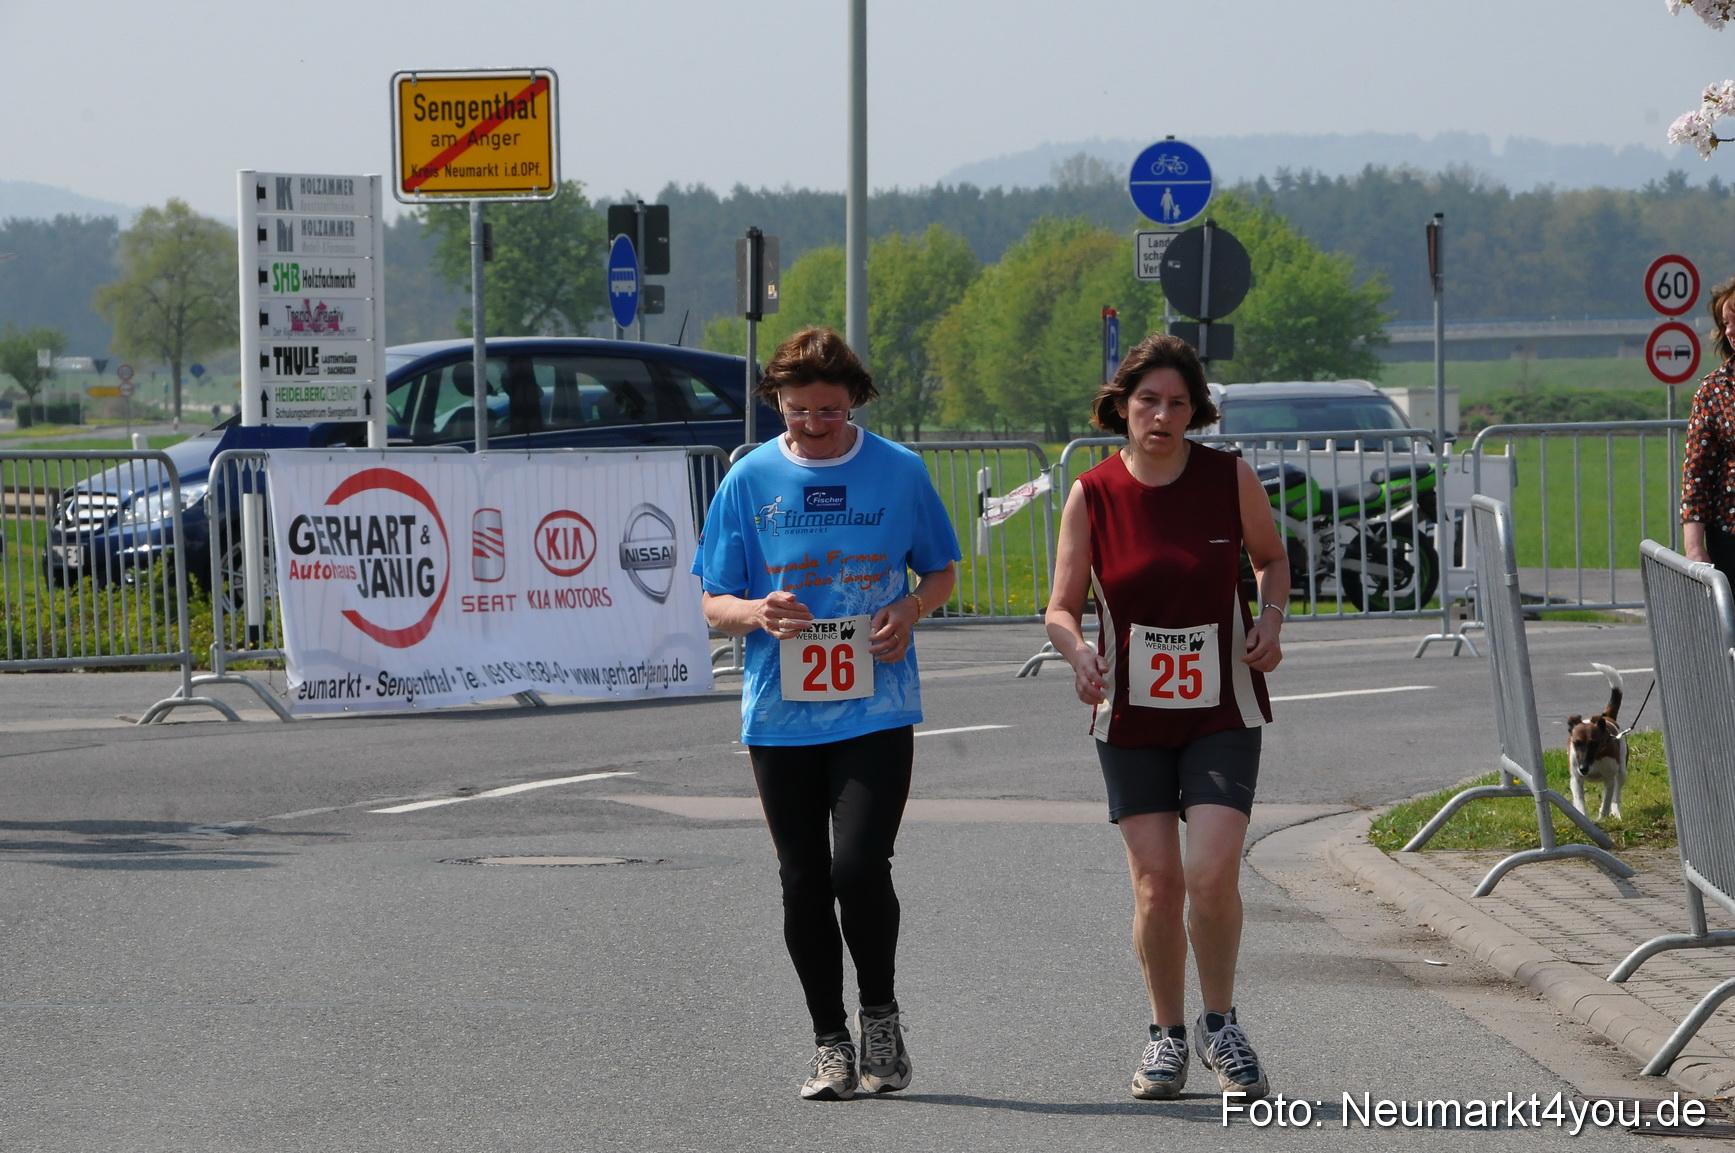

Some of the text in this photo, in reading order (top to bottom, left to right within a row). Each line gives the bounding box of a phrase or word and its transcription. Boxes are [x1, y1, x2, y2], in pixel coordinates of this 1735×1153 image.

[414, 91, 537, 129] Sengenthal
[431, 130, 520, 151] am Anger
[411, 162, 542, 178] Kreis Neumarkt i.d.OPf.
[300, 177, 354, 196] HOLZAMMER
[301, 219, 355, 237] HOLZAMMER
[1148, 237, 1170, 248] Land
[273, 262, 355, 294] SHB Holzfachmarkt
[1143, 263, 1159, 274] Ver
[1657, 271, 1688, 300] 60
[273, 346, 319, 375] THULE
[275, 406, 357, 420] Schulungszentrum Sengenthal
[813, 494, 844, 503] Fischer
[784, 508, 885, 527] firmenlauf
[288, 514, 431, 556] GERHART &
[785, 526, 828, 535] neumarkt
[545, 528, 586, 560] KIA
[827, 550, 887, 566] Firmen
[289, 559, 357, 580] Autohaus
[357, 557, 435, 598] JÄNIG
[461, 594, 517, 612] SEAT
[527, 587, 613, 609] KIA MOTORS
[796, 632, 838, 640] WERBUNG
[1145, 631, 1186, 643] MEYER
[1145, 641, 1187, 651] WERBUNG
[803, 643, 855, 691] 26
[1150, 653, 1203, 700] 25
[298, 672, 362, 700] eumarkt
[376, 668, 452, 702] Sengenthal
